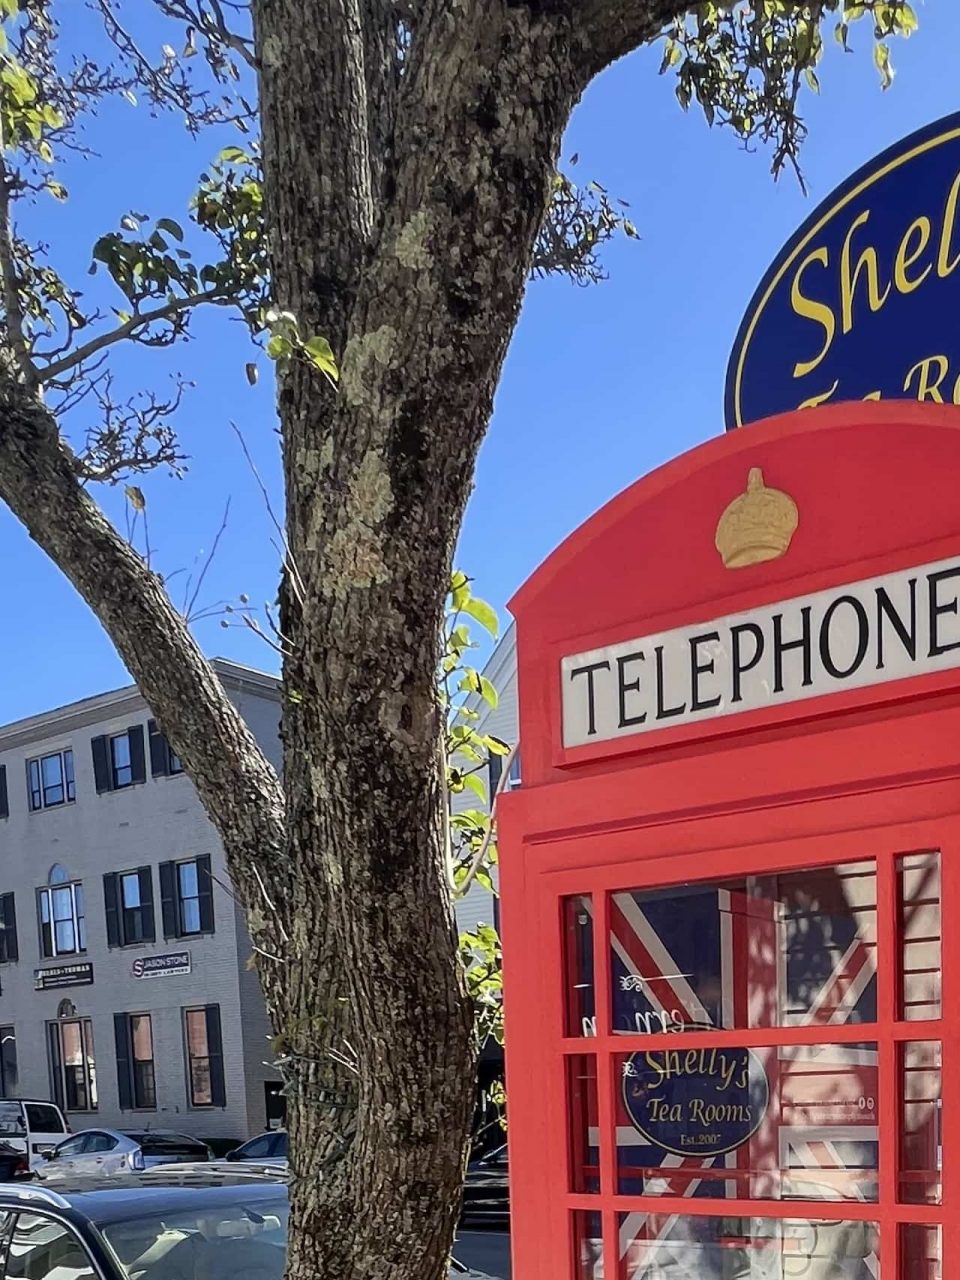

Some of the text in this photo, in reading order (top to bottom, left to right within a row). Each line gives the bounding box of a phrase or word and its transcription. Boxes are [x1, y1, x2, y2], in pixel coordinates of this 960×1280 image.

[646, 1048, 750, 1091] Shelly's
[646, 1095, 752, 1127] Tea Rooms
